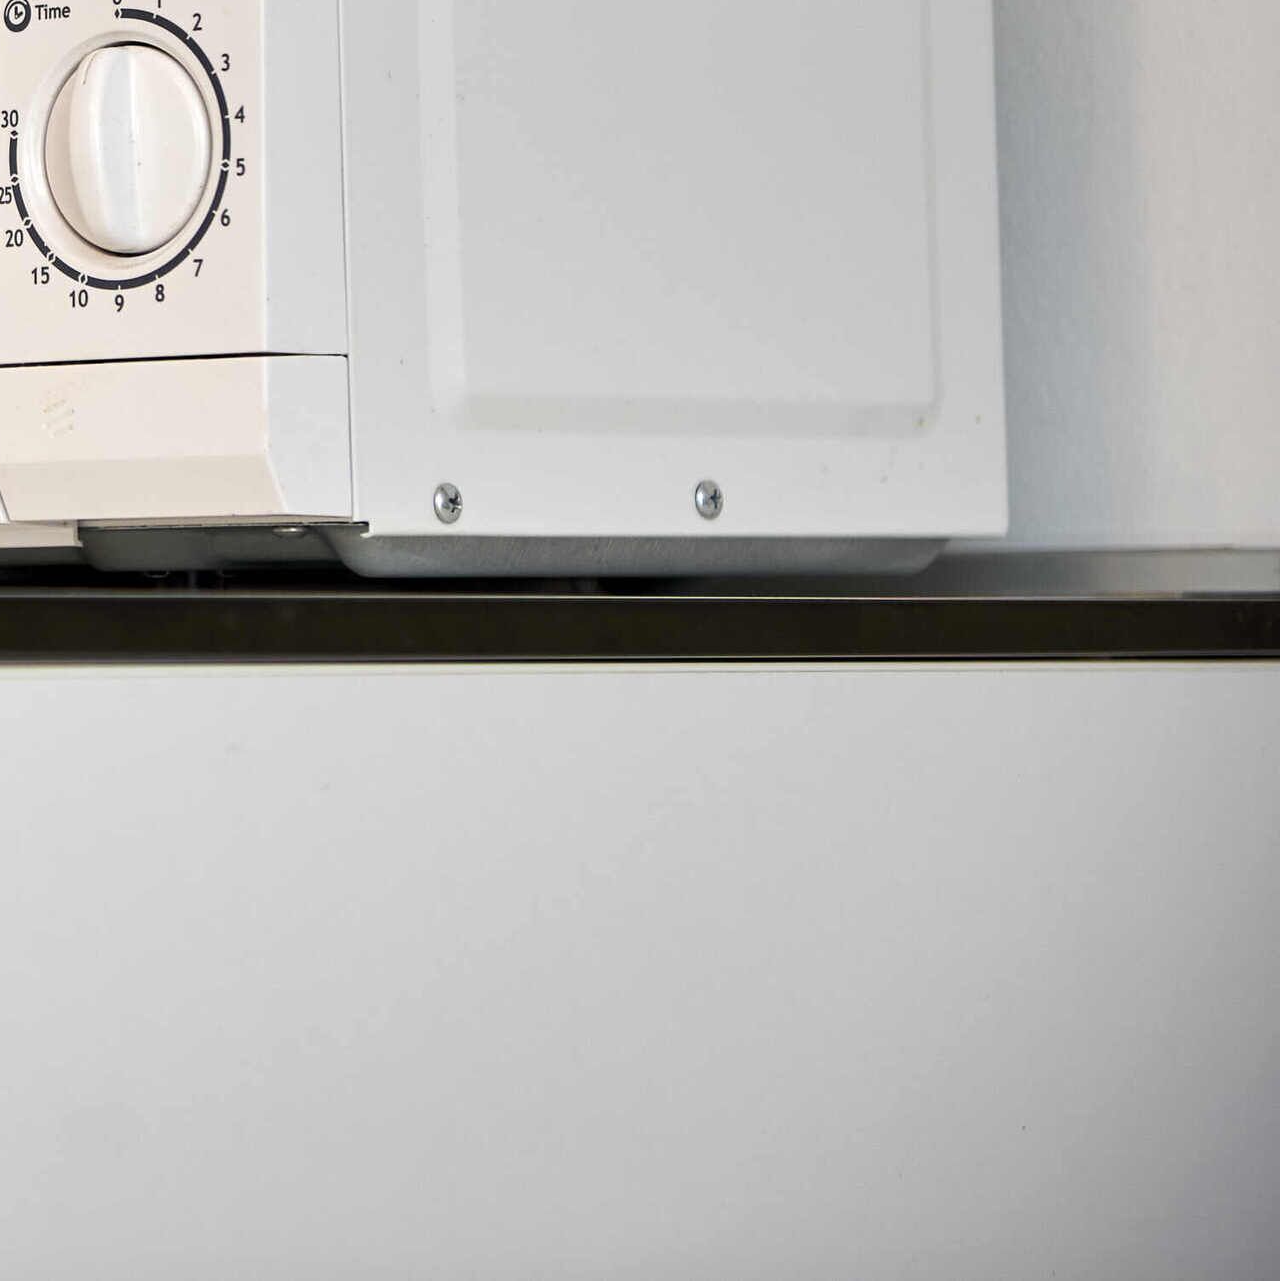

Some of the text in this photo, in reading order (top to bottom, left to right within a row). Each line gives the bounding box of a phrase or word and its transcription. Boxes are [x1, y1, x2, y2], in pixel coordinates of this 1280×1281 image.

[35, 3, 71, 21] Time
[192, 13, 203, 32] 2
[220, 53, 231, 72] 3
[0, 109, 19, 129] 30
[234, 105, 246, 124] 4
[236, 158, 246, 177] 5
[220, 209, 231, 227] 6
[4, 229, 24, 248] 20
[31, 266, 50, 286] 15
[193, 259, 204, 278] 7
[68, 289, 89, 308] 10
[155, 284, 166, 303] 8
[114, 294, 125, 313] 9
